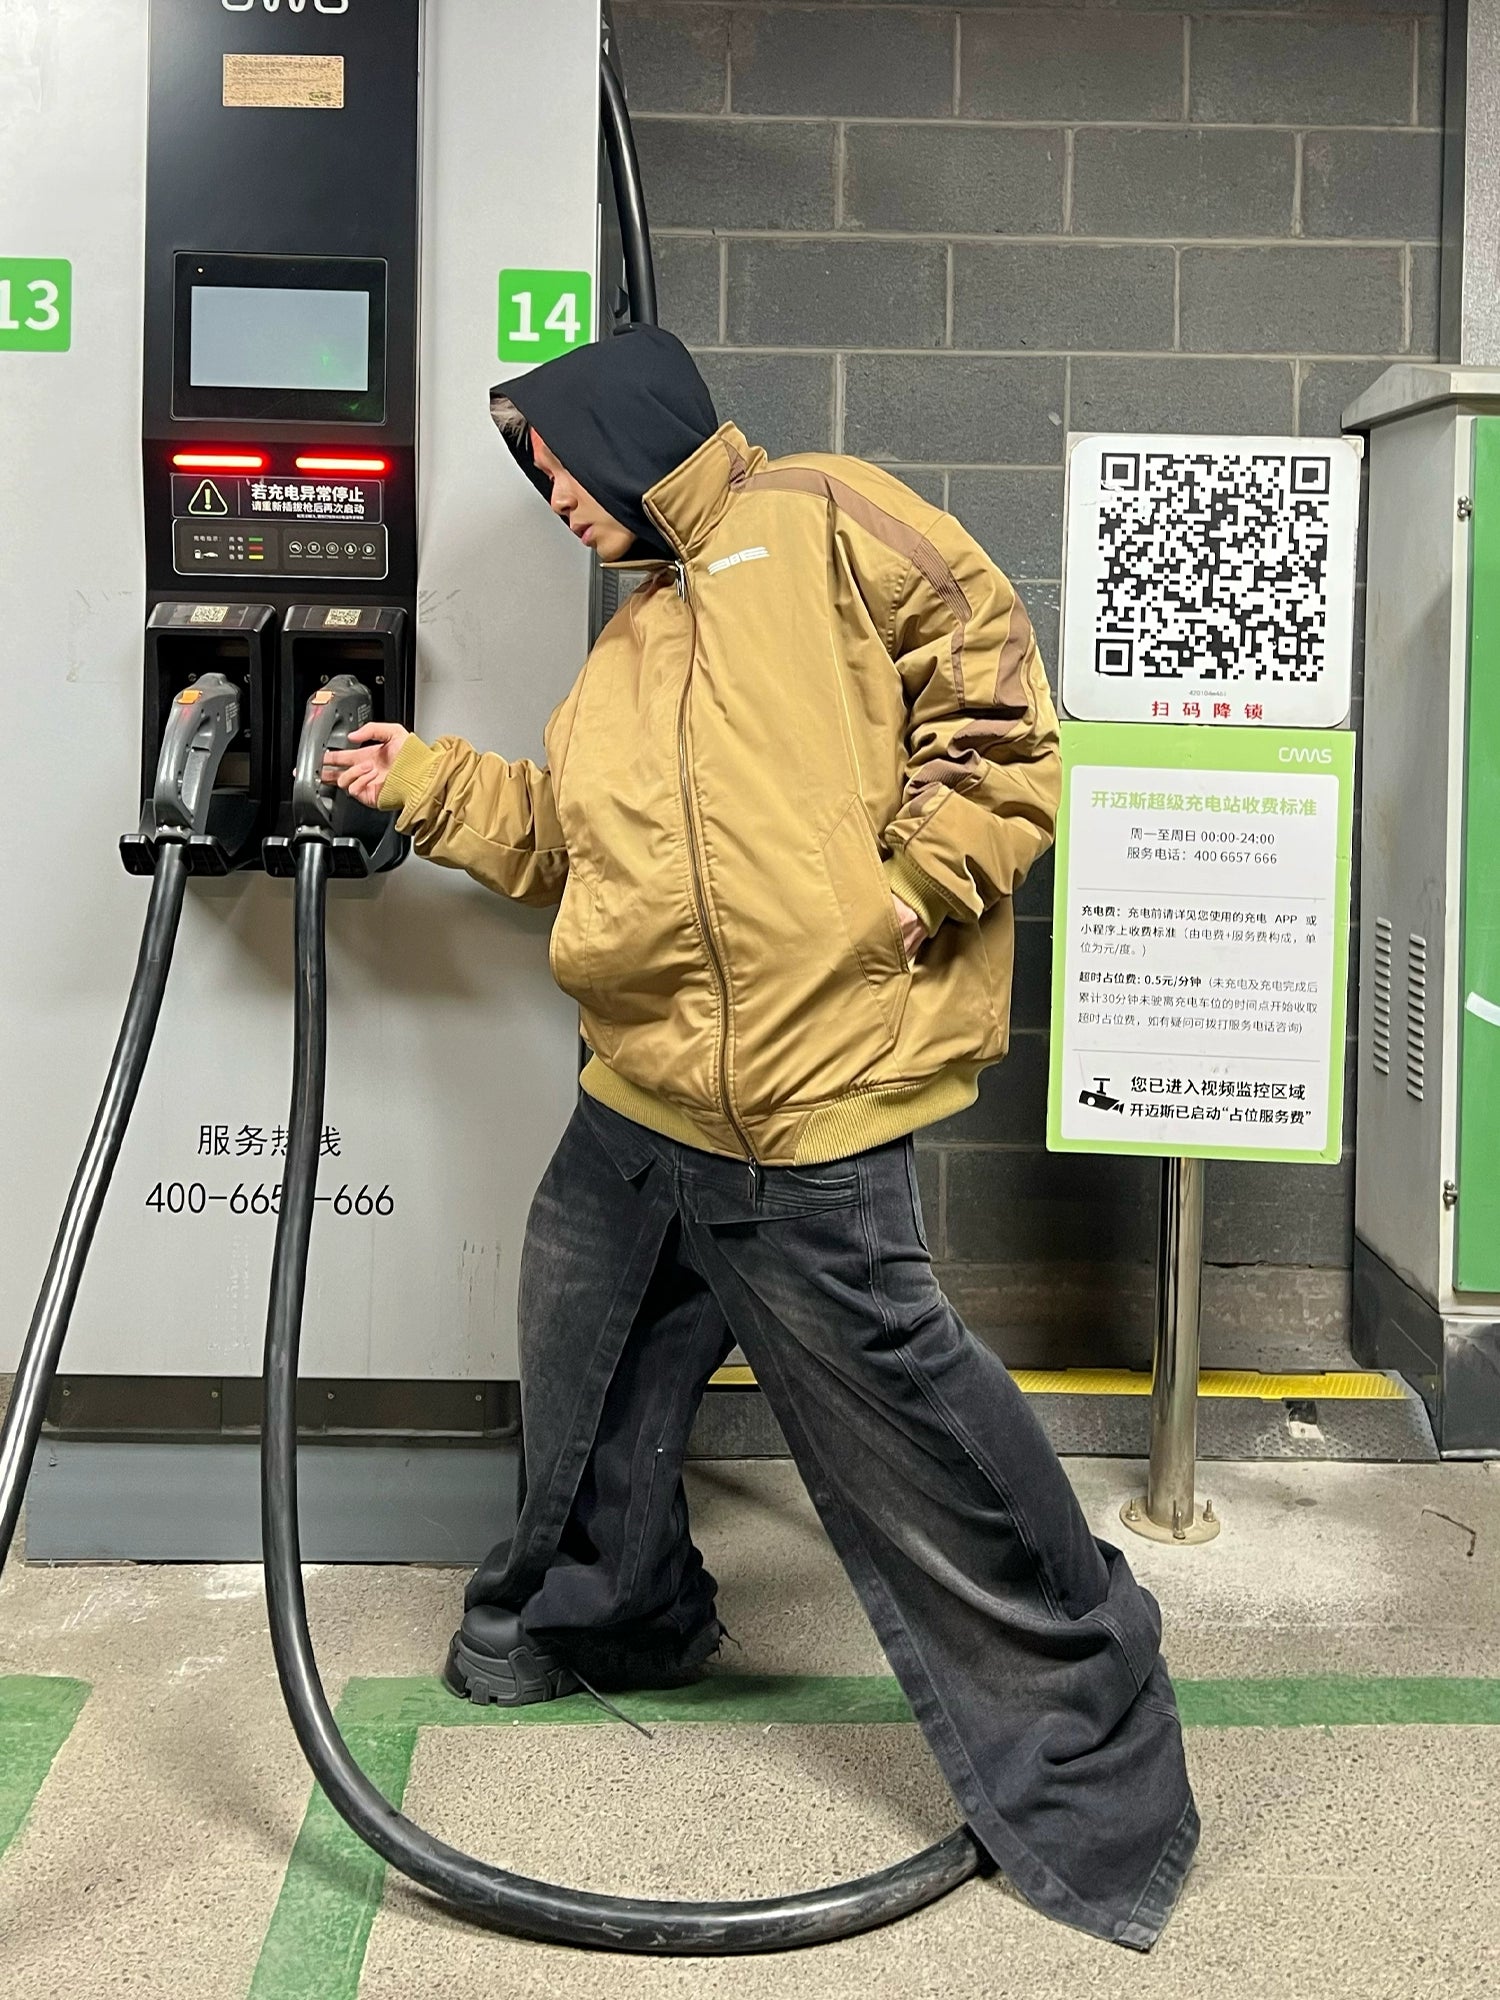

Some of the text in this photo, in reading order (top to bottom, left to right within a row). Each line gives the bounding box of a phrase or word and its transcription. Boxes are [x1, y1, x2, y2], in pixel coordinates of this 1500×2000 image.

[0, 279, 60, 331] 13
[508, 291, 581, 343] 14
[251, 483, 365, 503] 若充电异常停止
[251, 500, 365, 515] 请重新插拔枪后再次启动
[1091, 790, 1317, 816] 开迈斯超级充电站收费标准
[1130, 828, 1275, 845] 周一至周日 00:00-24:00
[1220, 851, 1250, 864] 6657
[1254, 852, 1278, 865] 666
[1274, 914, 1298, 924] APP
[1306, 915, 1317, 927] 或
[1131, 1076, 1306, 1100] 您已进入视频监控区域
[145, 1182, 395, 1216] 400-665-666
